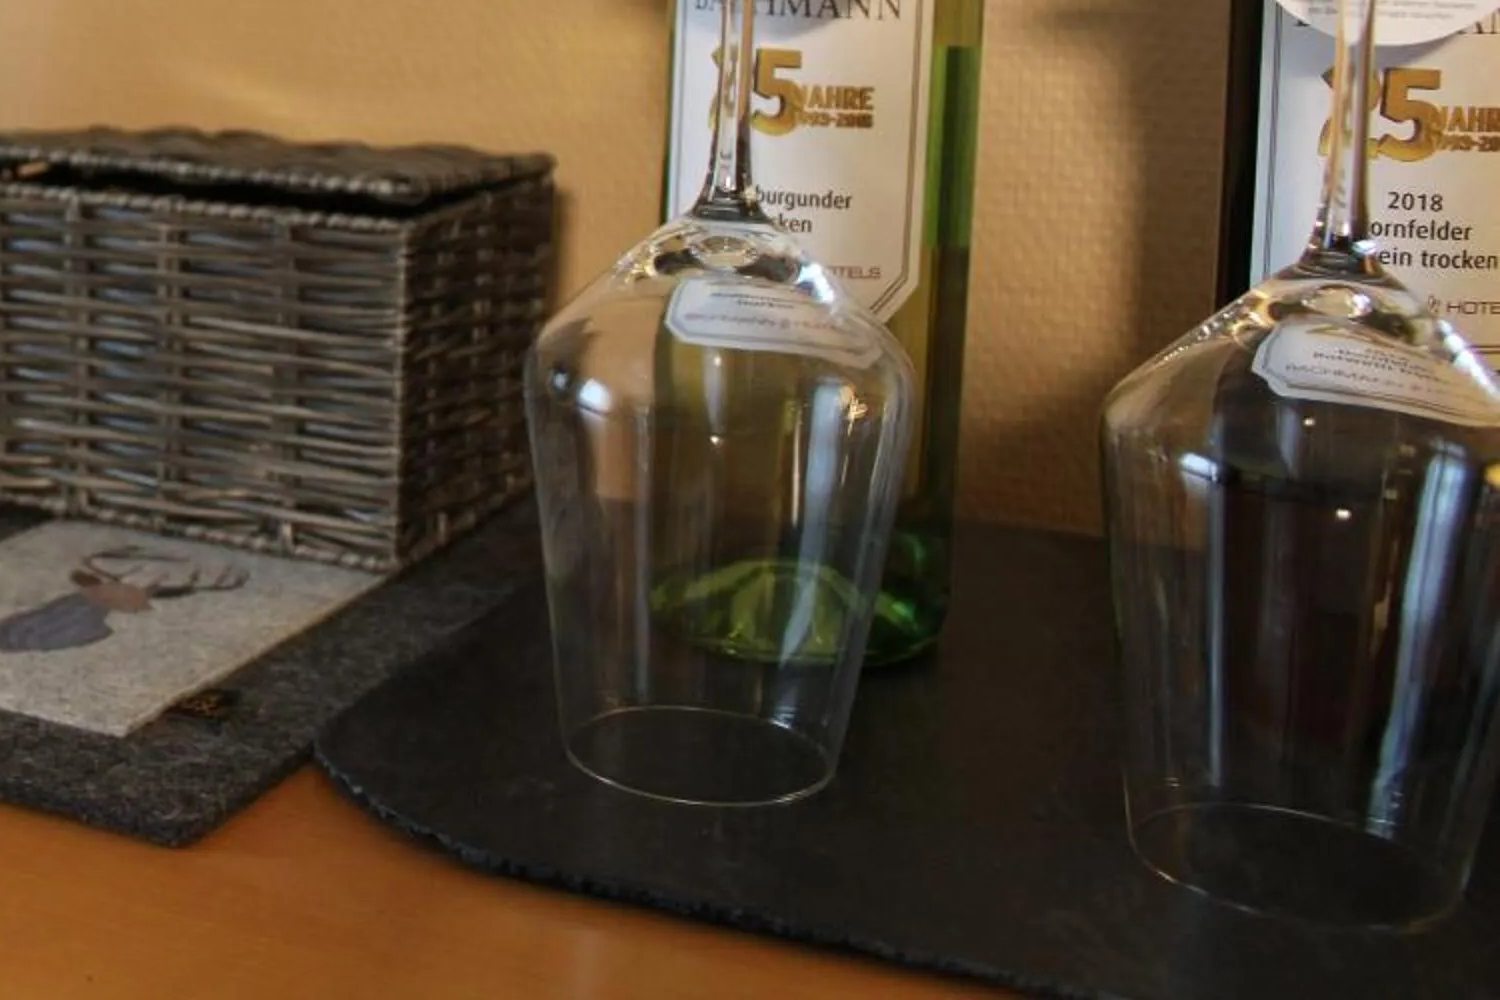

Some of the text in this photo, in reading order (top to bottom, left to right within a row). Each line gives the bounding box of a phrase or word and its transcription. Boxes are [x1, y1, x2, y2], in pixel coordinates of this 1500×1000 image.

[1432, 105, 1500, 133] JAHR
[755, 183, 853, 211] burgunder
[1387, 190, 1444, 213] 2018
[1370, 218, 1474, 241] ornfelder
[1378, 246, 1499, 270] ein trocken
[1445, 300, 1500, 316] HOTE
